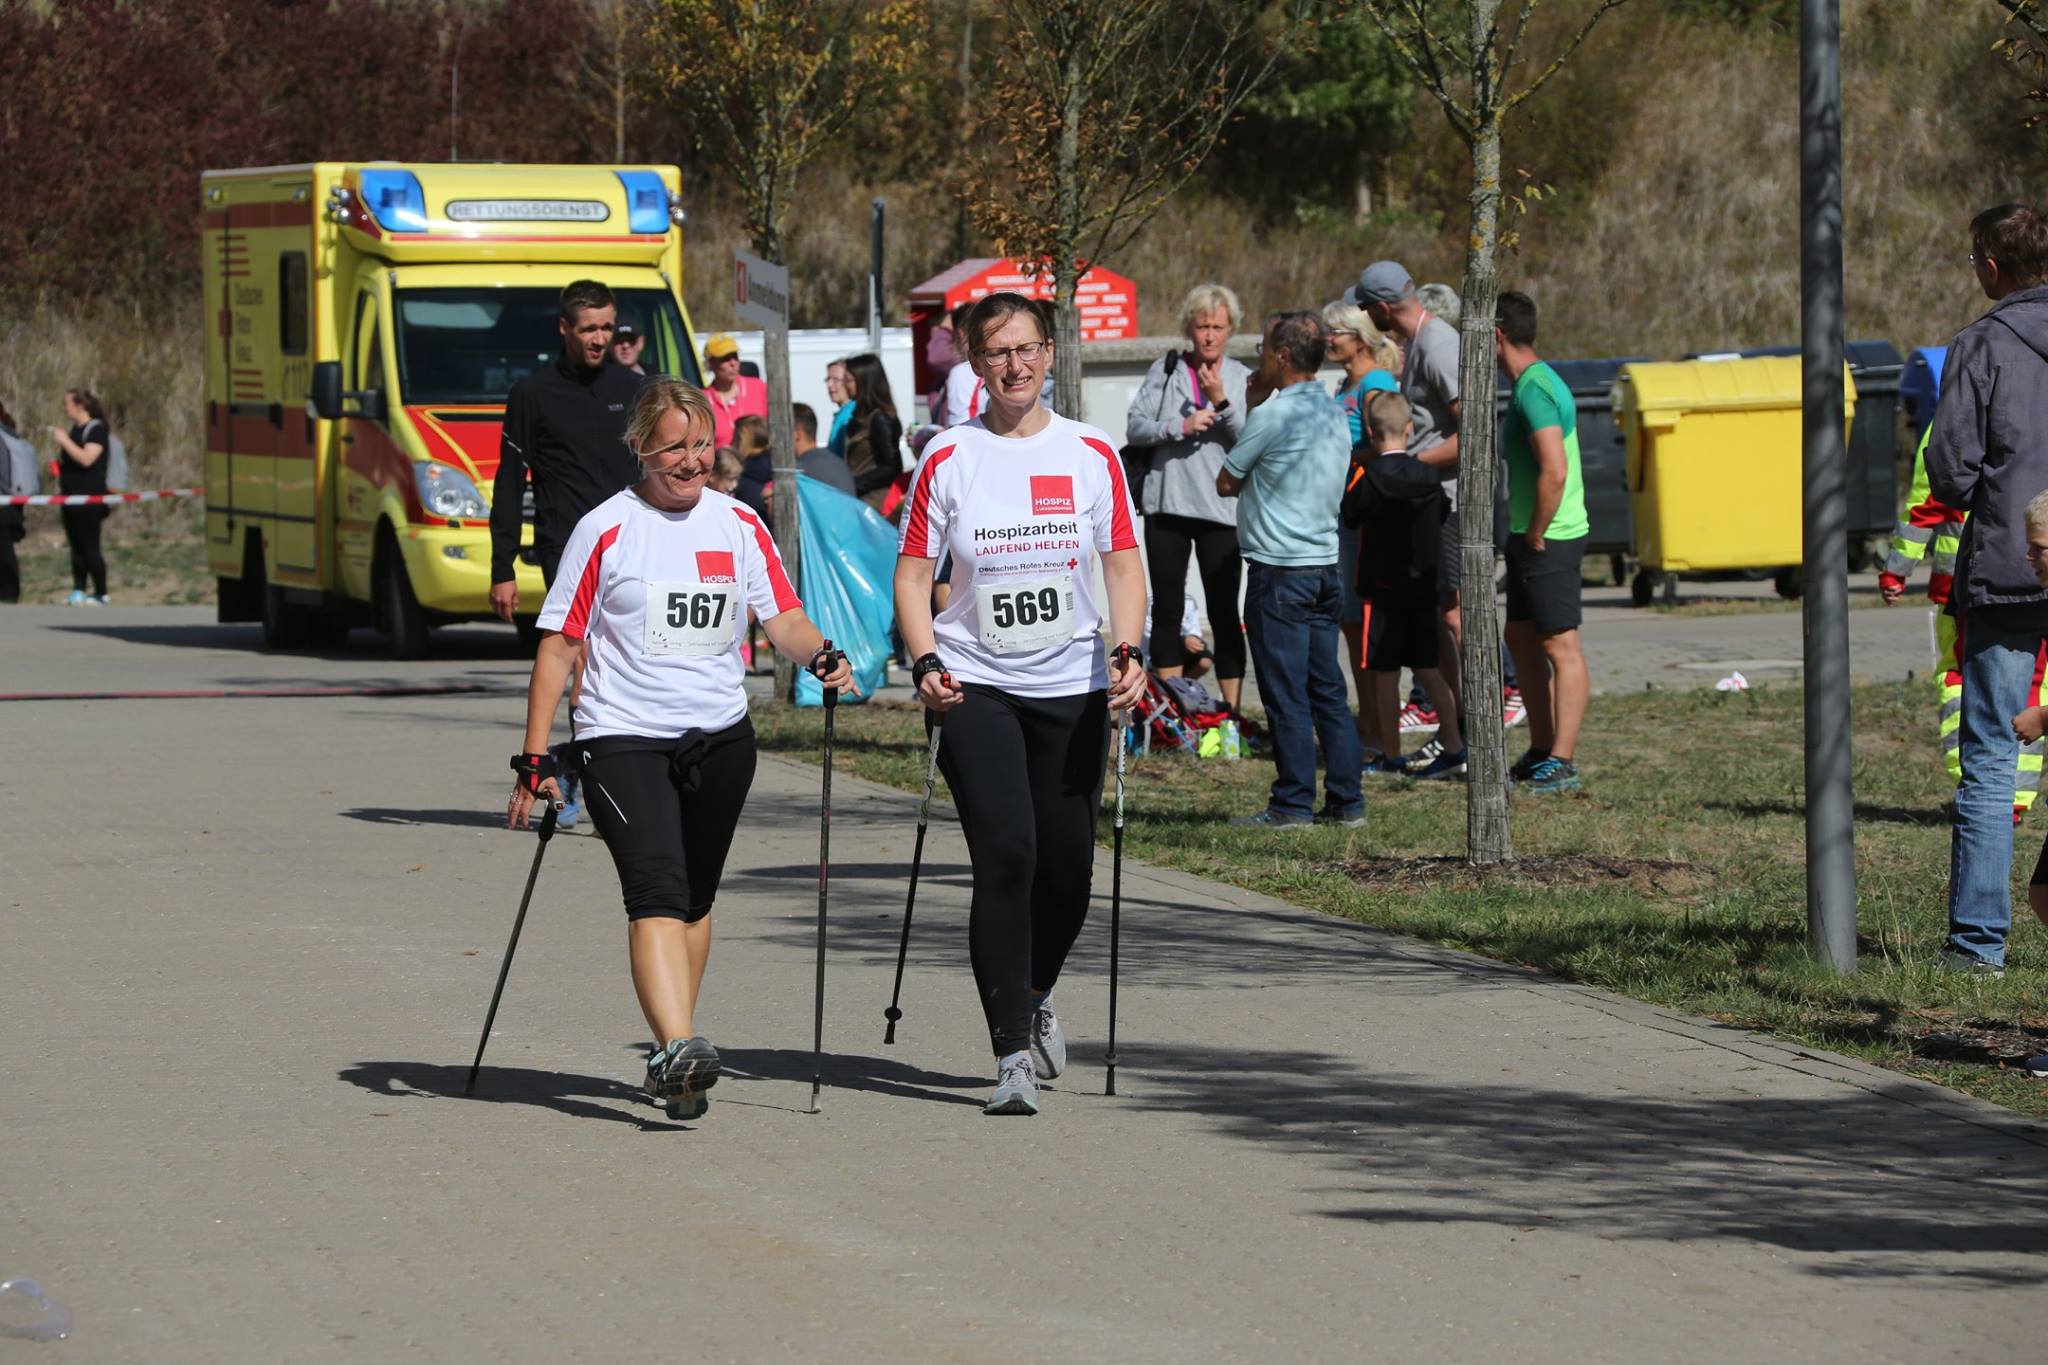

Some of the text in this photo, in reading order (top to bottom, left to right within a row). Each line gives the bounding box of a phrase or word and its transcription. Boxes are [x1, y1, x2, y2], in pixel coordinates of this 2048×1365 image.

[452, 203, 600, 216] RETTUNGSDIENST
[1035, 497, 1072, 506] HOSPIZ
[974, 521, 1079, 541] Hospizarbeit
[975, 540, 1080, 557] LAUFEND HELFEN
[978, 565, 1019, 573] Deutsches
[666, 592, 727, 629] 567
[992, 587, 1060, 628] 569
